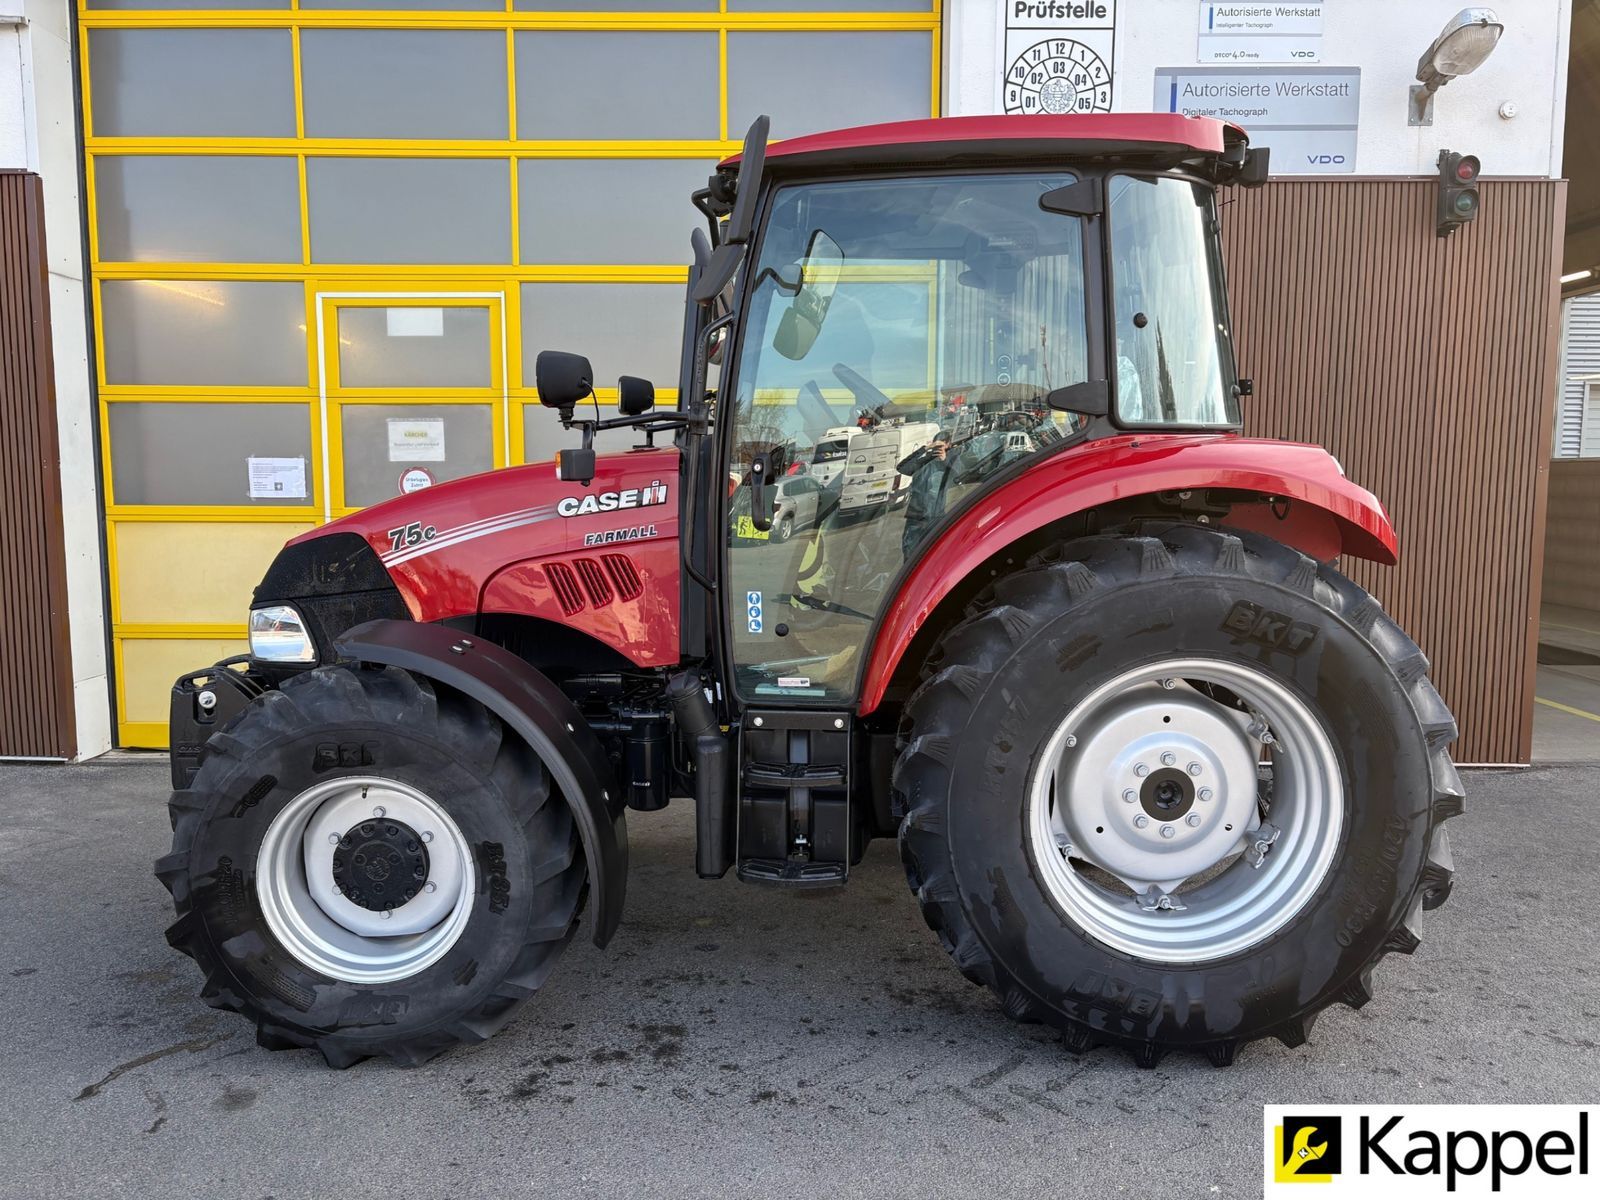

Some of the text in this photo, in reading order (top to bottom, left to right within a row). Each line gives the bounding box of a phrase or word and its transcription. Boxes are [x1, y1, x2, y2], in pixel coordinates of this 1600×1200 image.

[1015, 0, 1107, 18] Prüfstelle
[1217, 7, 1321, 17] Autorisierte Werkstatt
[1032, 49, 1041, 61] 11
[1055, 42, 1066, 55] 12
[1232, 50, 1245, 59] 4.0
[1080, 49, 1085, 62] 1
[1015, 66, 1025, 78] 10
[1053, 61, 1065, 74] 03
[1095, 66, 1101, 79] 2
[1031, 72, 1043, 85] 02
[1074, 73, 1087, 86] 04
[1182, 81, 1349, 97] Autorisierte Werkstatt
[1010, 90, 1016, 102] 9
[1025, 95, 1036, 108] 01
[1100, 91, 1107, 103] 3
[1078, 97, 1091, 110] 05
[1182, 107, 1268, 117] Digitaler Tachograph
[1307, 155, 1345, 164] VDO
[557, 488, 638, 518] CASE
[584, 525, 657, 546] FARMALL
[1224, 605, 1315, 651] BKT
